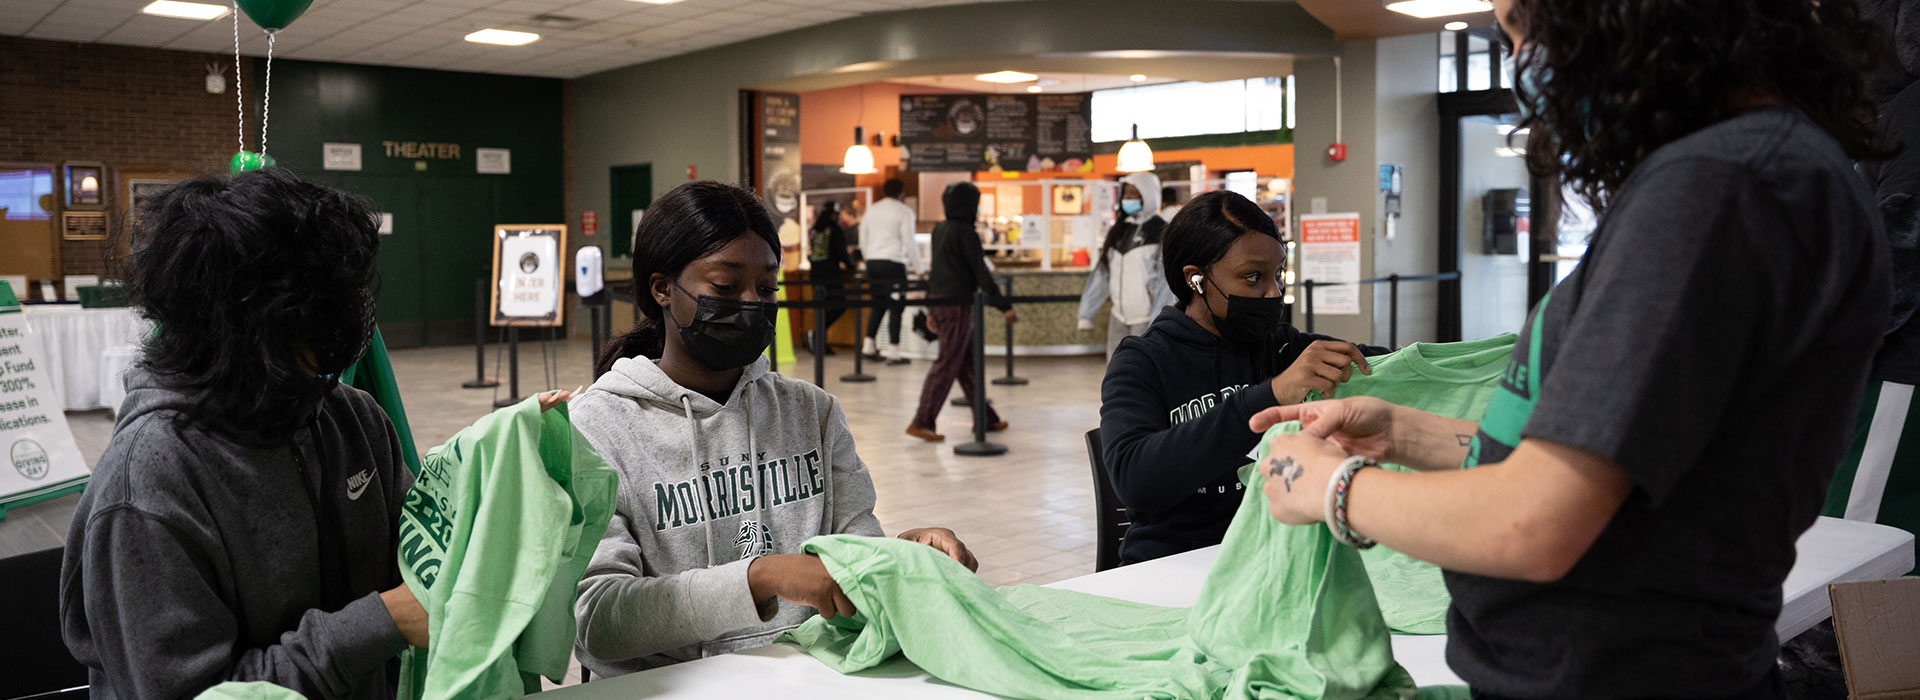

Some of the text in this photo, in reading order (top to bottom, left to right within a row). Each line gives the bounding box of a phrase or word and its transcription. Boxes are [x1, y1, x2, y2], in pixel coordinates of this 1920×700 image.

[382, 140, 461, 160] THEATER
[0, 344, 22, 356] ent
[5, 358, 35, 373] Fund
[1506, 360, 1528, 390] LE
[0, 377, 35, 392] 300%
[26, 395, 39, 407] in
[27, 465, 42, 475] DAY
[700, 451, 767, 472] SUNY
[347, 468, 369, 491] NIKE
[1198, 482, 1243, 494] MUS
[654, 447, 825, 532] MORRISVILLE
[400, 515, 443, 590] ING
